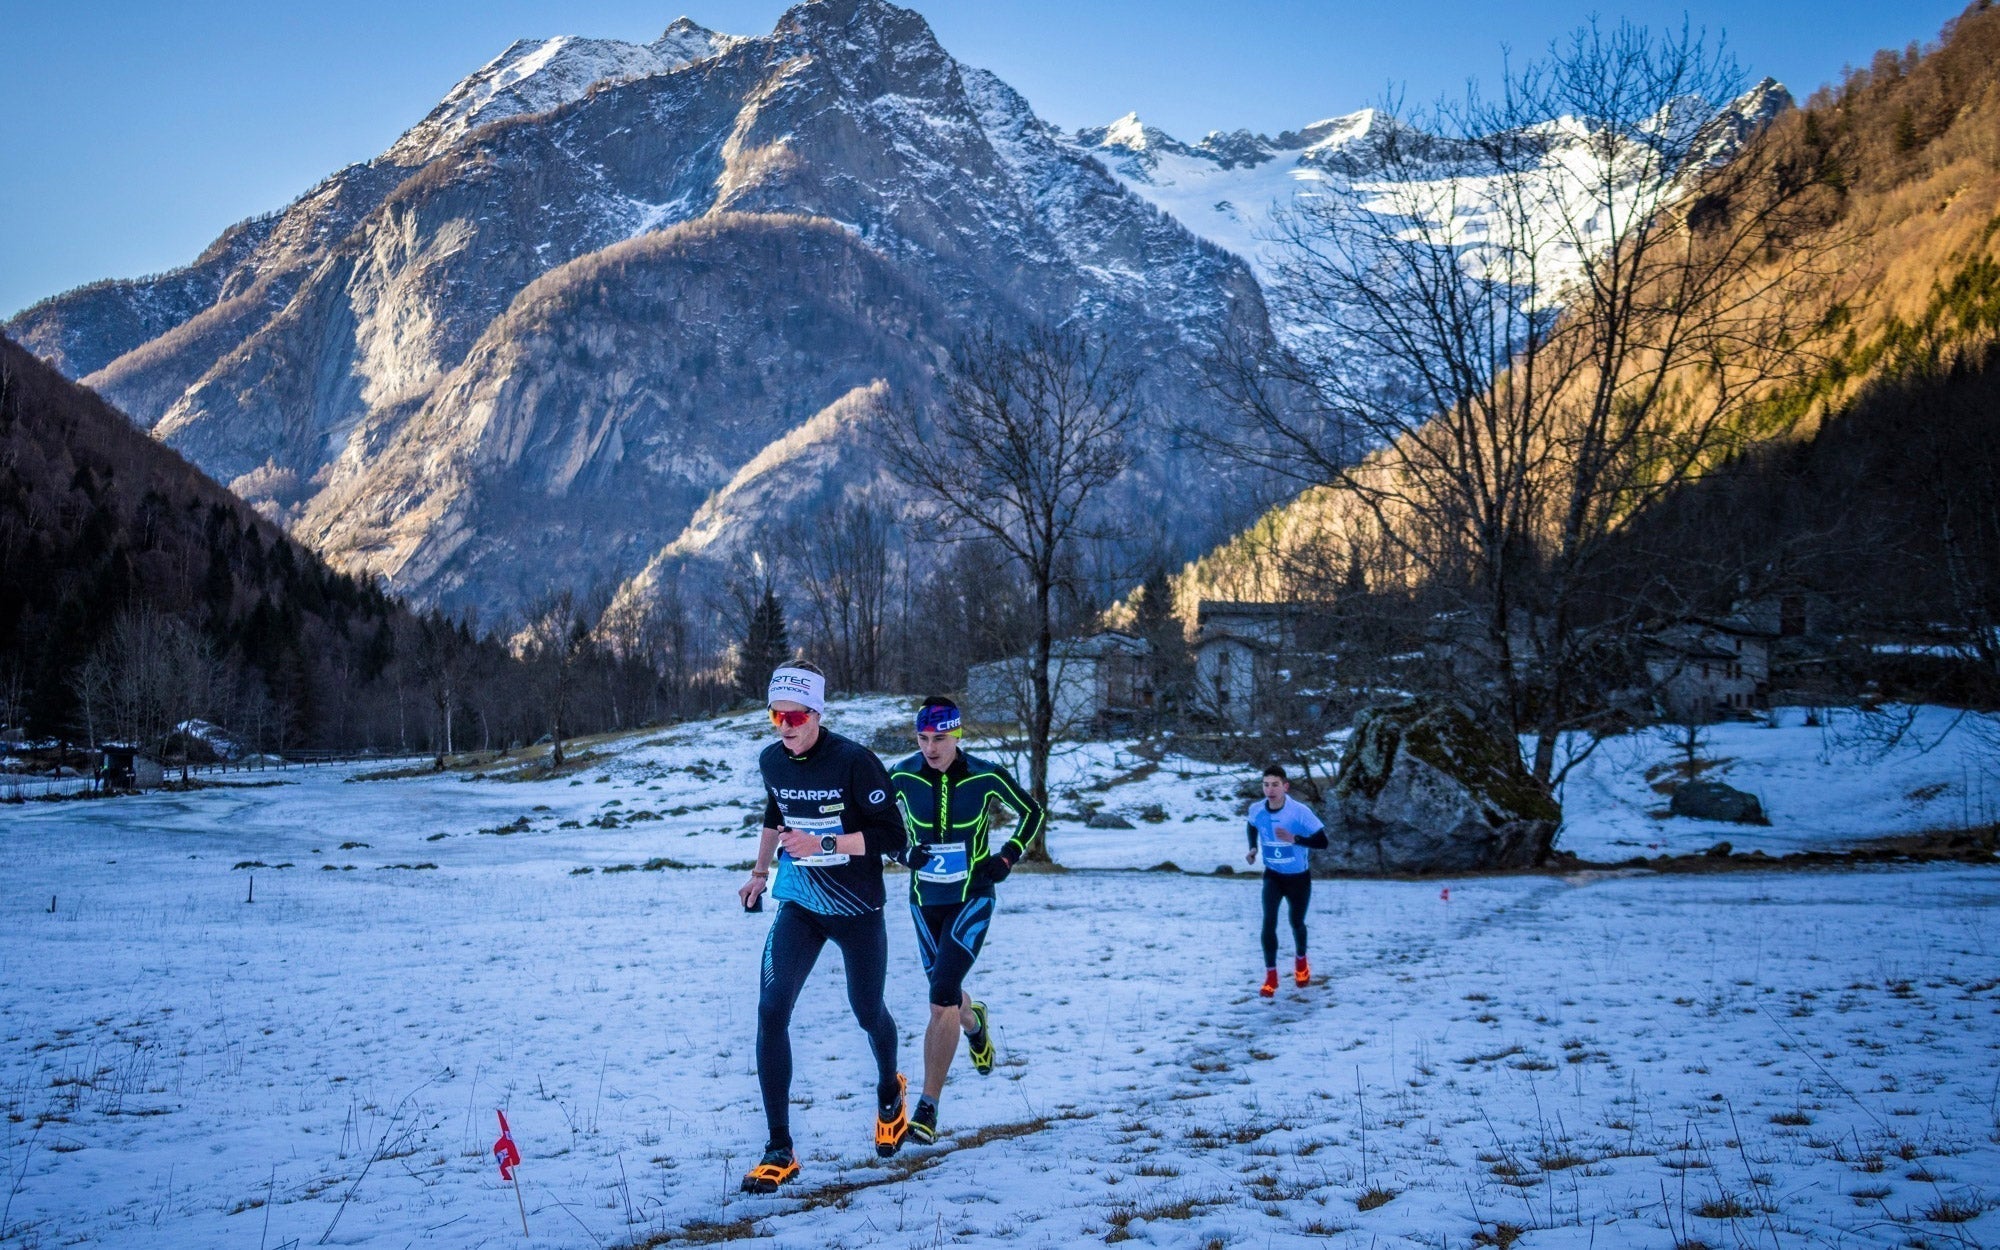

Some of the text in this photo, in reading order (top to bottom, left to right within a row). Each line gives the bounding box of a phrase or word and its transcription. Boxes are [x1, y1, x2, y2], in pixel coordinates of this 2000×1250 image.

[780, 789, 842, 800] SCARPA
[1274, 847, 1282, 858] 6
[933, 854, 947, 873] 2
